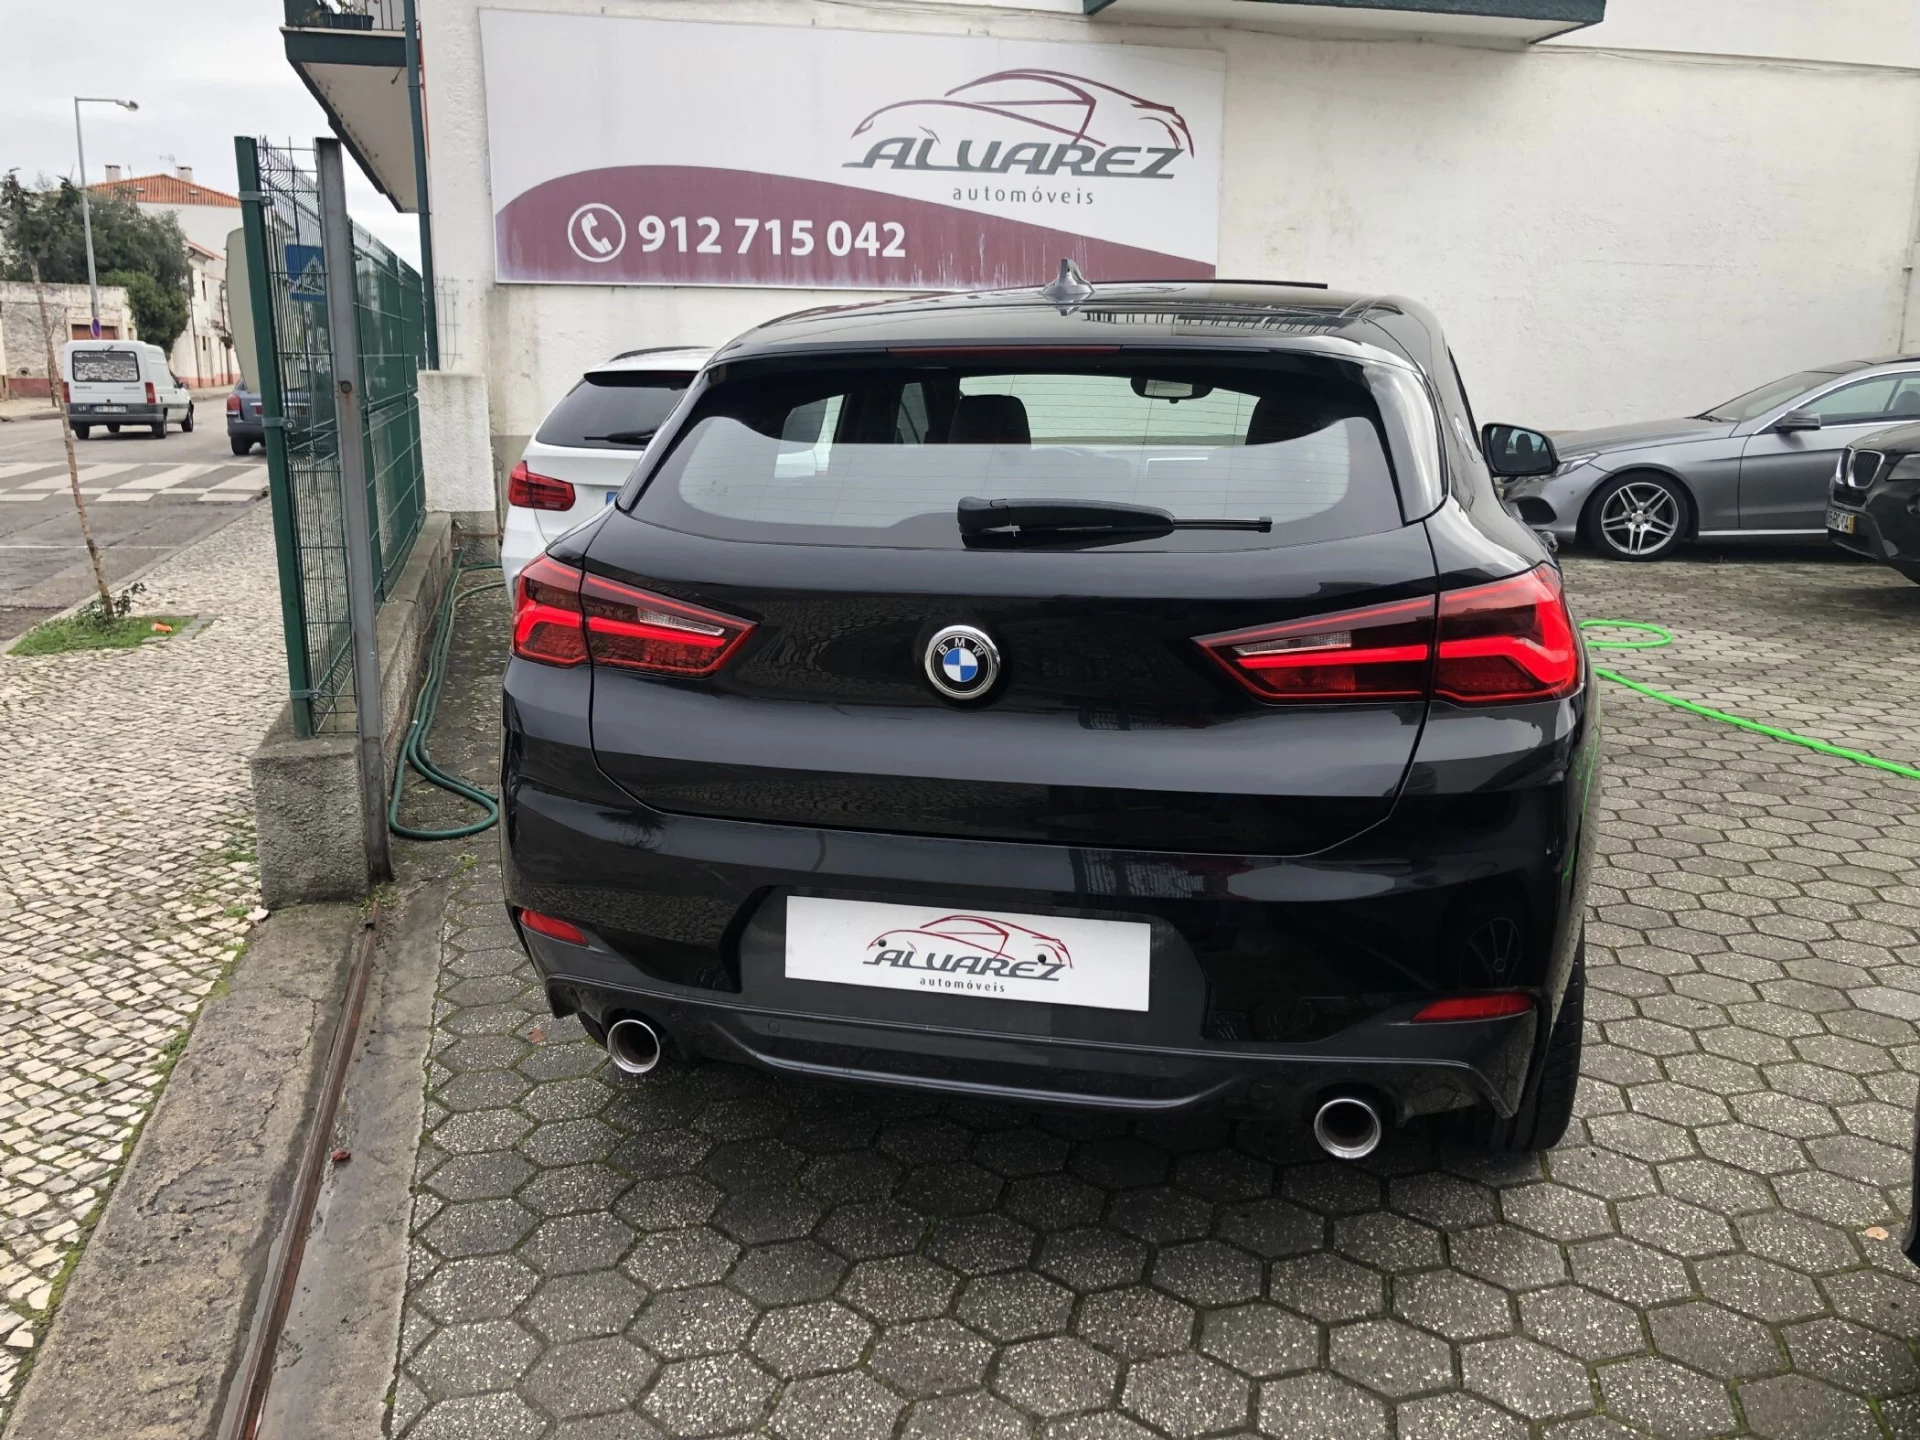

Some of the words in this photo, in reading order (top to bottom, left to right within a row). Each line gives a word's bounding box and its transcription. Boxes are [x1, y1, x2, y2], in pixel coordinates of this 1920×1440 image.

[842, 136, 1185, 180] ALVAREZ
[952, 186, 1094, 205] automóveis
[638, 215, 722, 254] 912
[734, 217, 815, 256] 715
[826, 220, 906, 258] 042
[937, 637, 985, 657] BMW
[863, 949, 1066, 982] ALVAREZ
[919, 976, 1006, 993] automóveis
